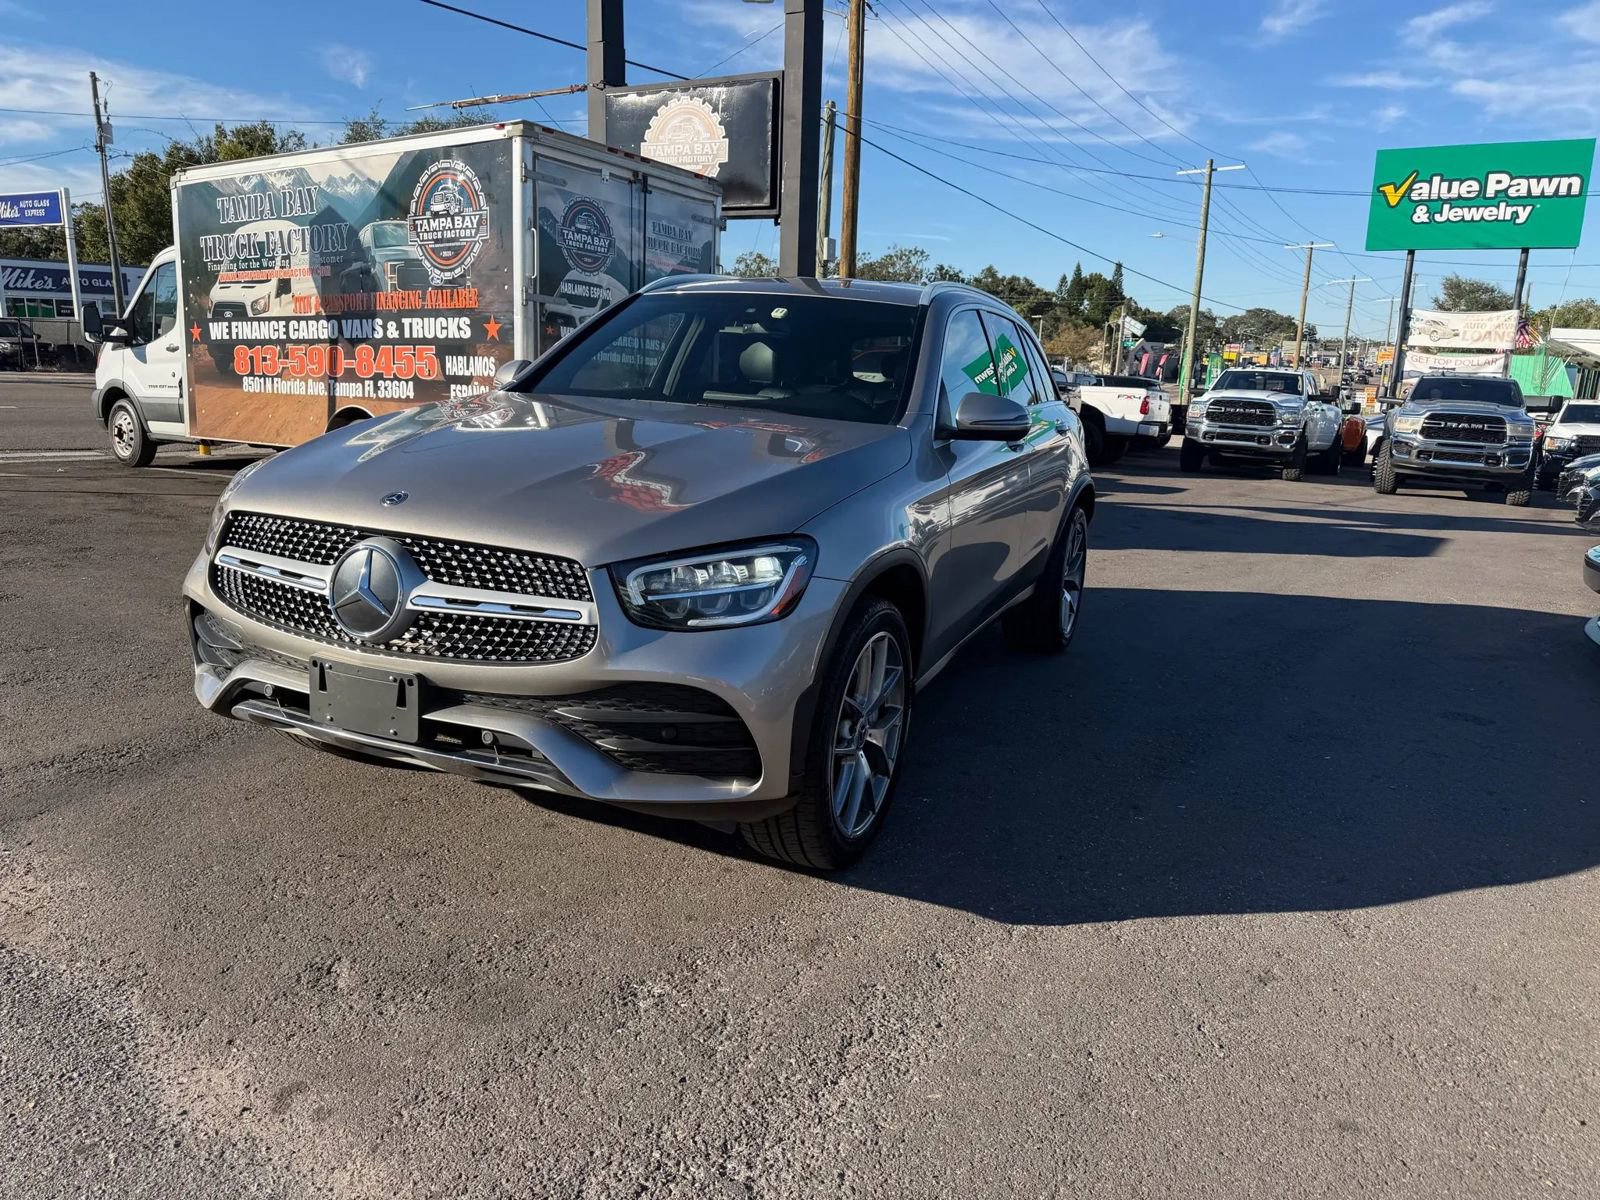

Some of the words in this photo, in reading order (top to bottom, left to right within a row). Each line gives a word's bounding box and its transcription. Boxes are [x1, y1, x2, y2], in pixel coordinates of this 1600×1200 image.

[648, 144, 692, 157] TAMPA
[694, 143, 720, 154] BAY
[1486, 173, 1581, 198] Pawn
[20, 200, 33, 208] AUTO
[33, 199, 50, 207] GLASS
[217, 192, 277, 224] TAMPA
[281, 186, 318, 218] BAY
[25, 209, 45, 217] EXPRESS
[1411, 205, 1430, 223] &
[1434, 203, 1532, 224] Jewelry
[416, 217, 454, 233] TAMPA
[454, 215, 480, 229] BAY
[200, 232, 260, 262] TRUCK
[264, 222, 349, 258] FACTORY
[419, 231, 442, 240] TRUCK
[443, 229, 476, 239] FACTORY
[563, 230, 593, 245] TAMPA
[592, 237, 610, 248] BAY
[239, 260, 248, 269] for
[250, 259, 260, 268] the
[1, 268, 57, 289] Mike's
[560, 281, 589, 297] HABLAMOS
[370, 290, 422, 311] FINANCING
[424, 288, 479, 309] AVAILABLE
[209, 321, 229, 340] WE
[231, 320, 286, 340] FINANCE
[288, 319, 339, 340] CARGO
[341, 318, 384, 338] VANS
[387, 320, 399, 339] &
[402, 317, 471, 339] TRUCKS
[1463, 322, 1487, 330] AUTO
[1461, 330, 1515, 343] LOANS
[234, 344, 437, 379] 813-590-8455
[445, 355, 496, 377] HABLAMOS
[1411, 354, 1429, 364] GET
[1434, 358, 1452, 367] TOP
[1454, 358, 1498, 367] DOLLAR
[242, 376, 264, 393] 8501
[265, 377, 273, 393] N
[274, 377, 304, 395] Florida
[307, 378, 328, 396] Ave.
[329, 380, 363, 399] Tampa
[377, 381, 414, 399] 33604
